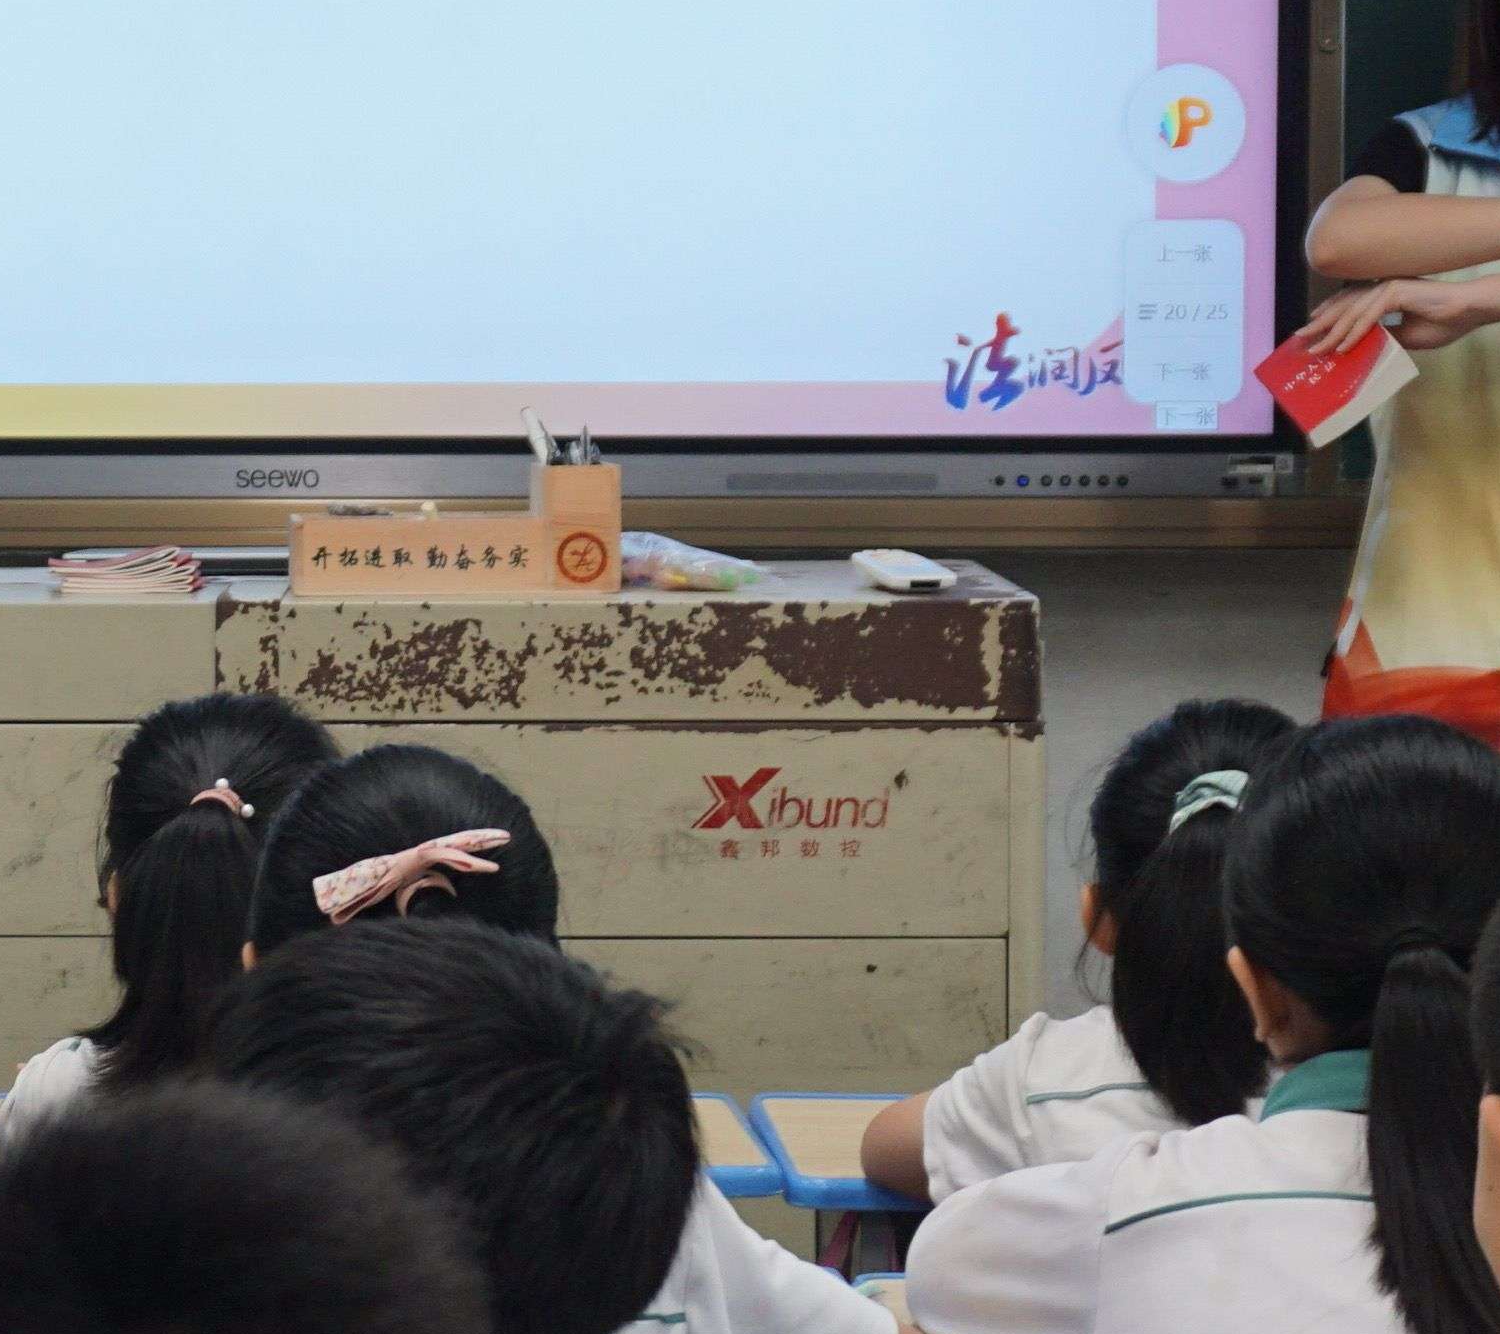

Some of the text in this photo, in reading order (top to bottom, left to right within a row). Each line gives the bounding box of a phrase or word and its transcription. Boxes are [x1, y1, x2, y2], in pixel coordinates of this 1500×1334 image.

[1156, 243, 1214, 263] 上一张
[1154, 362, 1211, 381] 下一张
[1159, 406, 1215, 426] 下一张
[234, 466, 321, 490] seewo
[311, 544, 415, 570] 开拓进取
[425, 543, 530, 570] 勤奋务实
[690, 766, 891, 830] Xibund
